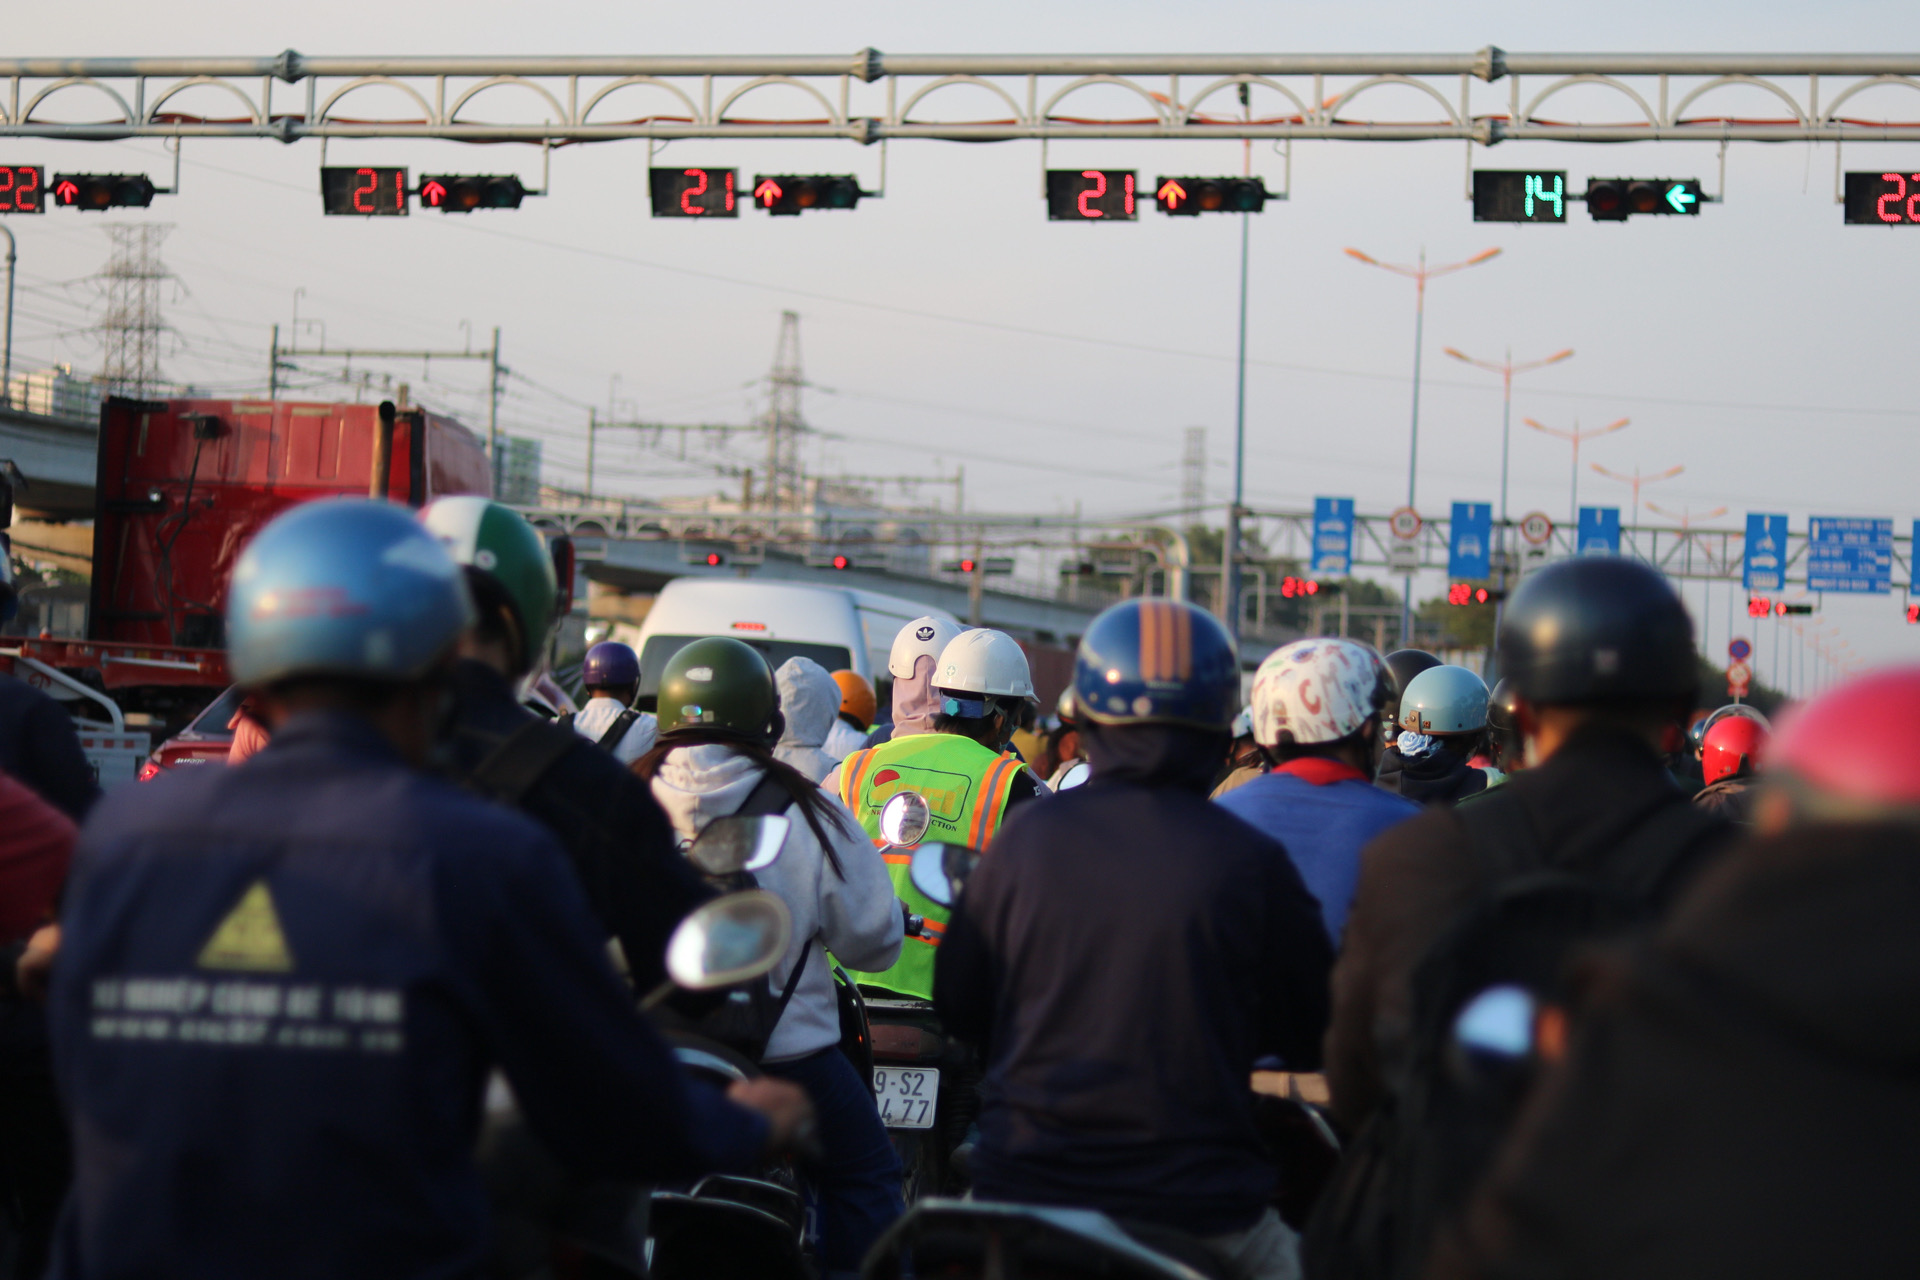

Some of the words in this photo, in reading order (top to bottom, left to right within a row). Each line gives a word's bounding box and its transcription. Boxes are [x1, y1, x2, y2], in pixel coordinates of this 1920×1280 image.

[353, 168, 404, 213] 21
[680, 169, 735, 215] 21
[1078, 171, 1135, 218] 21
[1524, 174, 1563, 218] 14
[875, 1071, 925, 1097] 9-S2
[881, 1098, 930, 1124] 477
